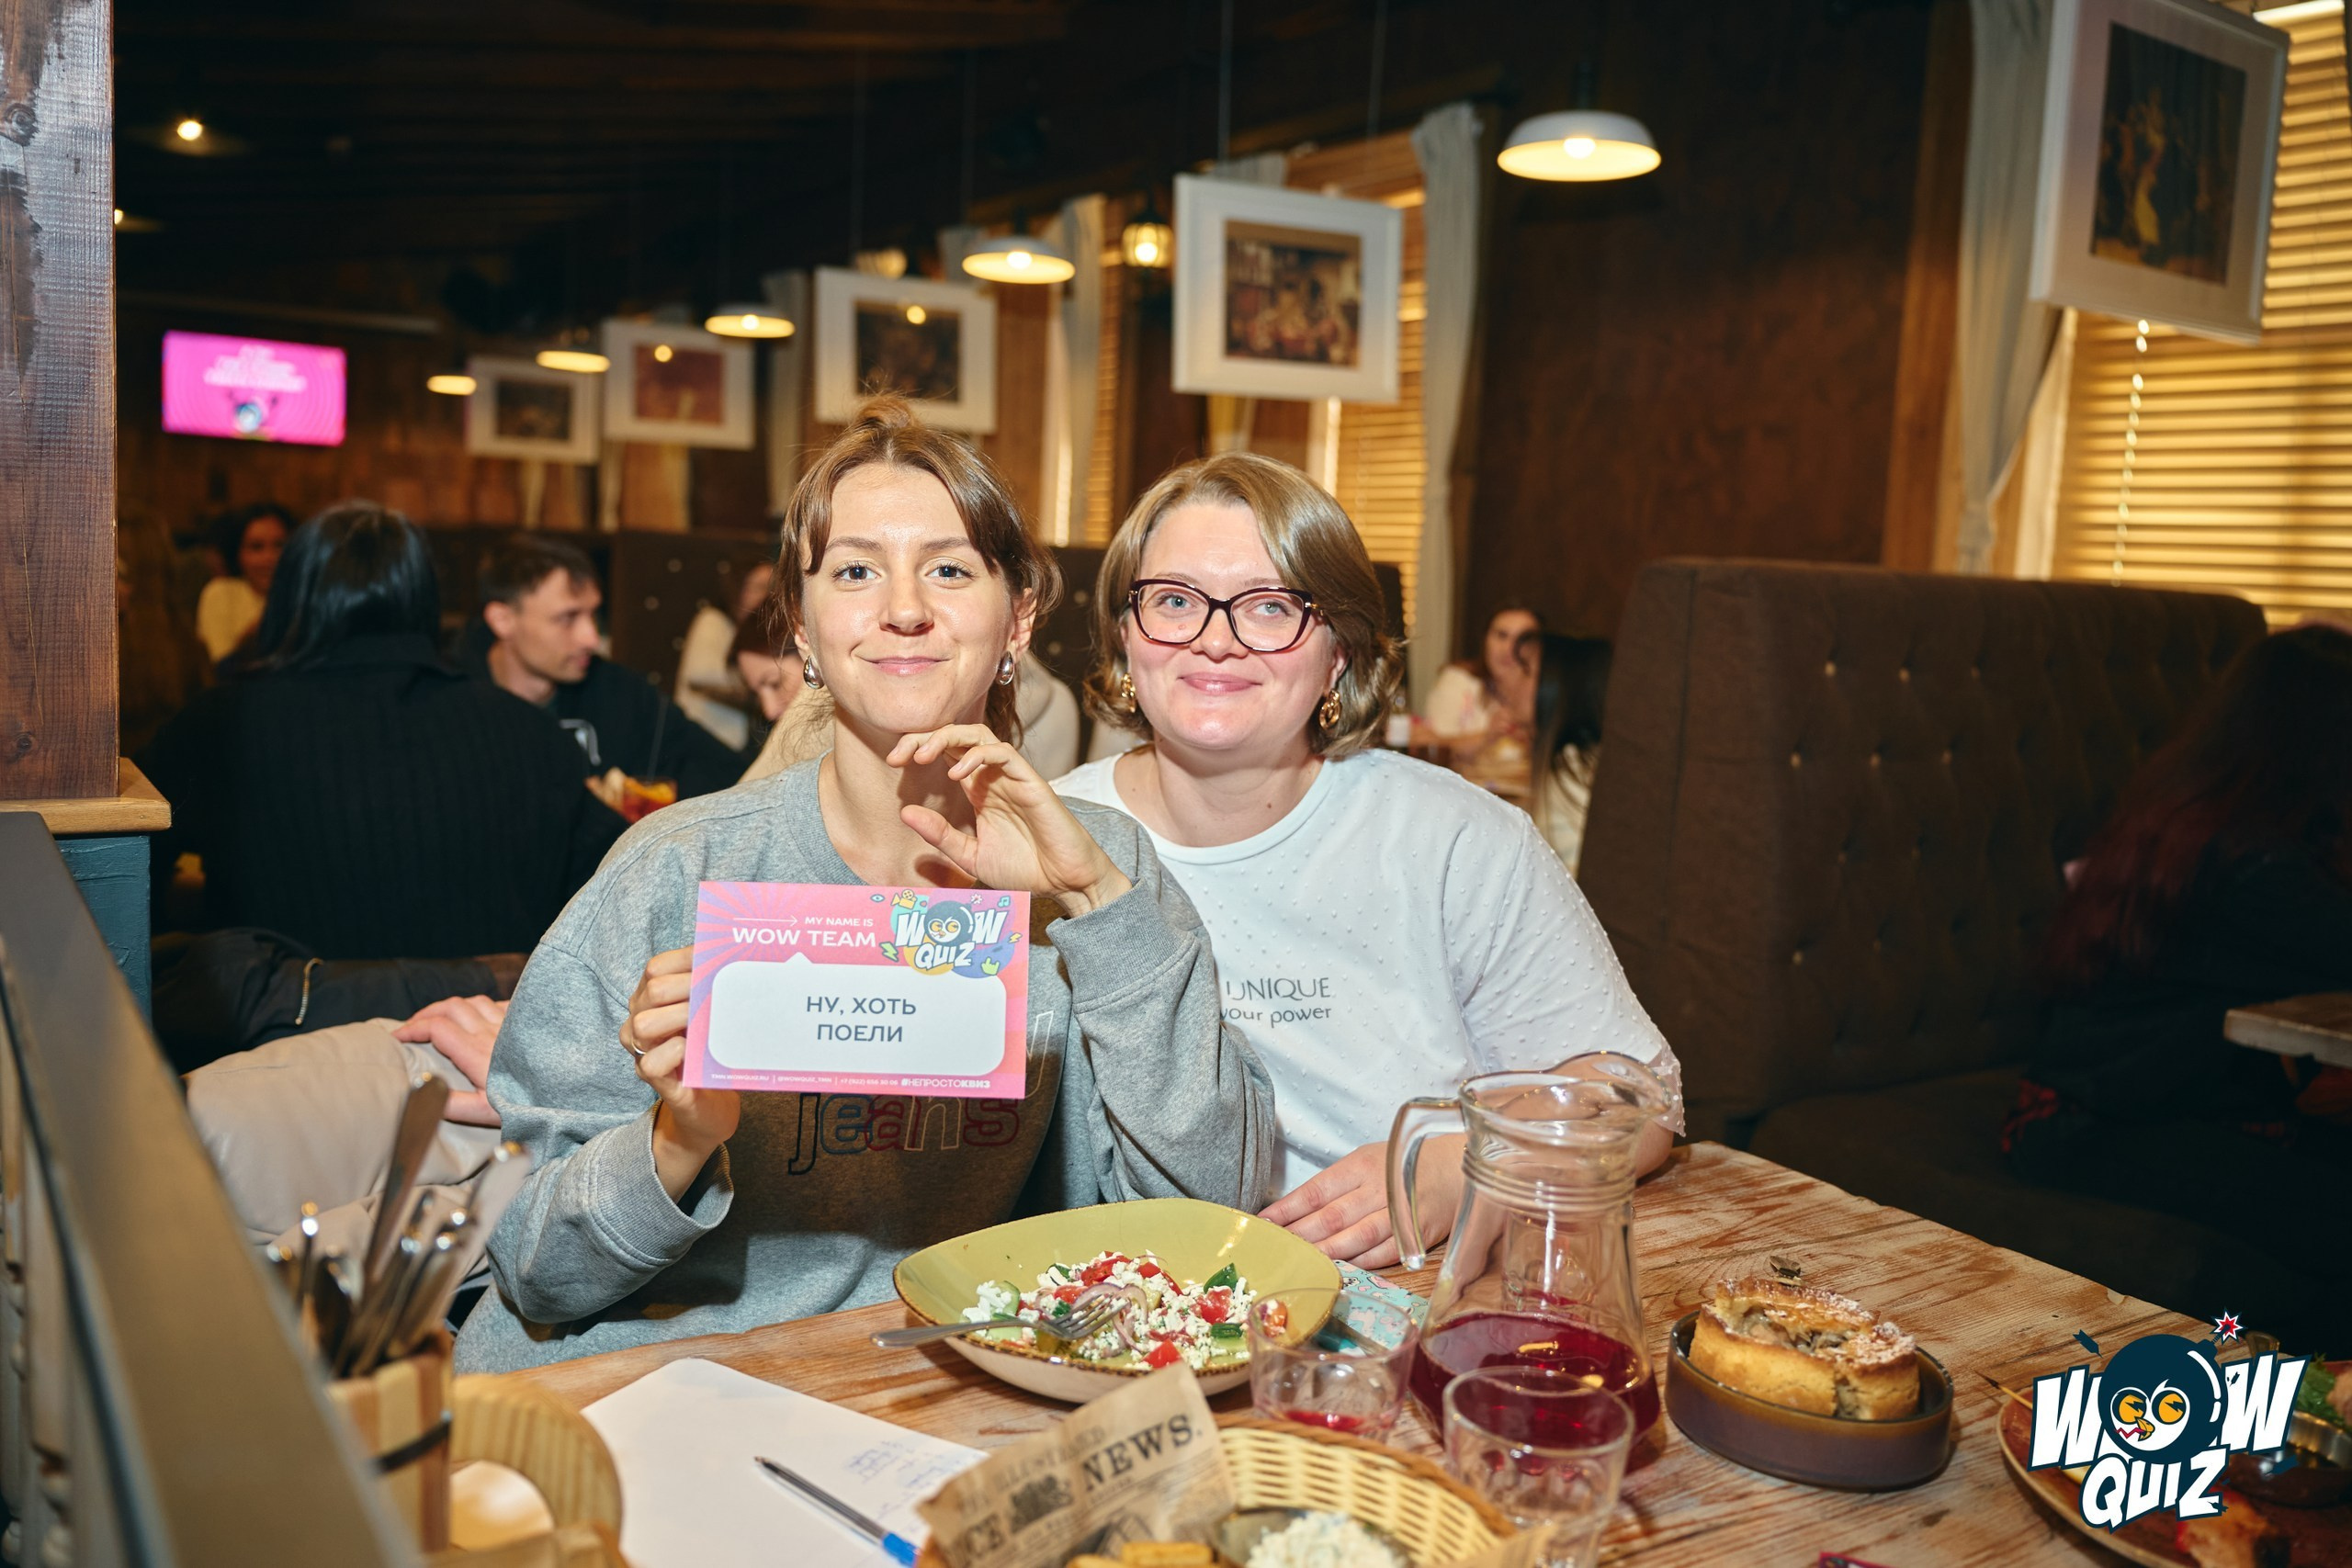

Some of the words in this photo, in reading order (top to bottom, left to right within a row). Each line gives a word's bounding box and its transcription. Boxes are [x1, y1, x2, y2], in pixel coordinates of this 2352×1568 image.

[804, 916, 824, 926] MY
[826, 917, 861, 927] NAME
[863, 919, 874, 927] IS
[894, 902, 1009, 948] WOW
[732, 927, 801, 946] WOW
[807, 930, 876, 948] TEAM
[913, 940, 977, 971] QUIZ
[1226, 976, 1331, 1001] UNIQUE
[806, 995, 844, 1015] НУ,
[852, 997, 917, 1015] ХОТЬ
[1270, 1007, 1332, 1029] power
[816, 1023, 903, 1043] ПОЕЛИ
[900, 1077, 991, 1089] #НЕПРОСТОКВИЗ
[1080, 1414, 1204, 1493] NEWS.
